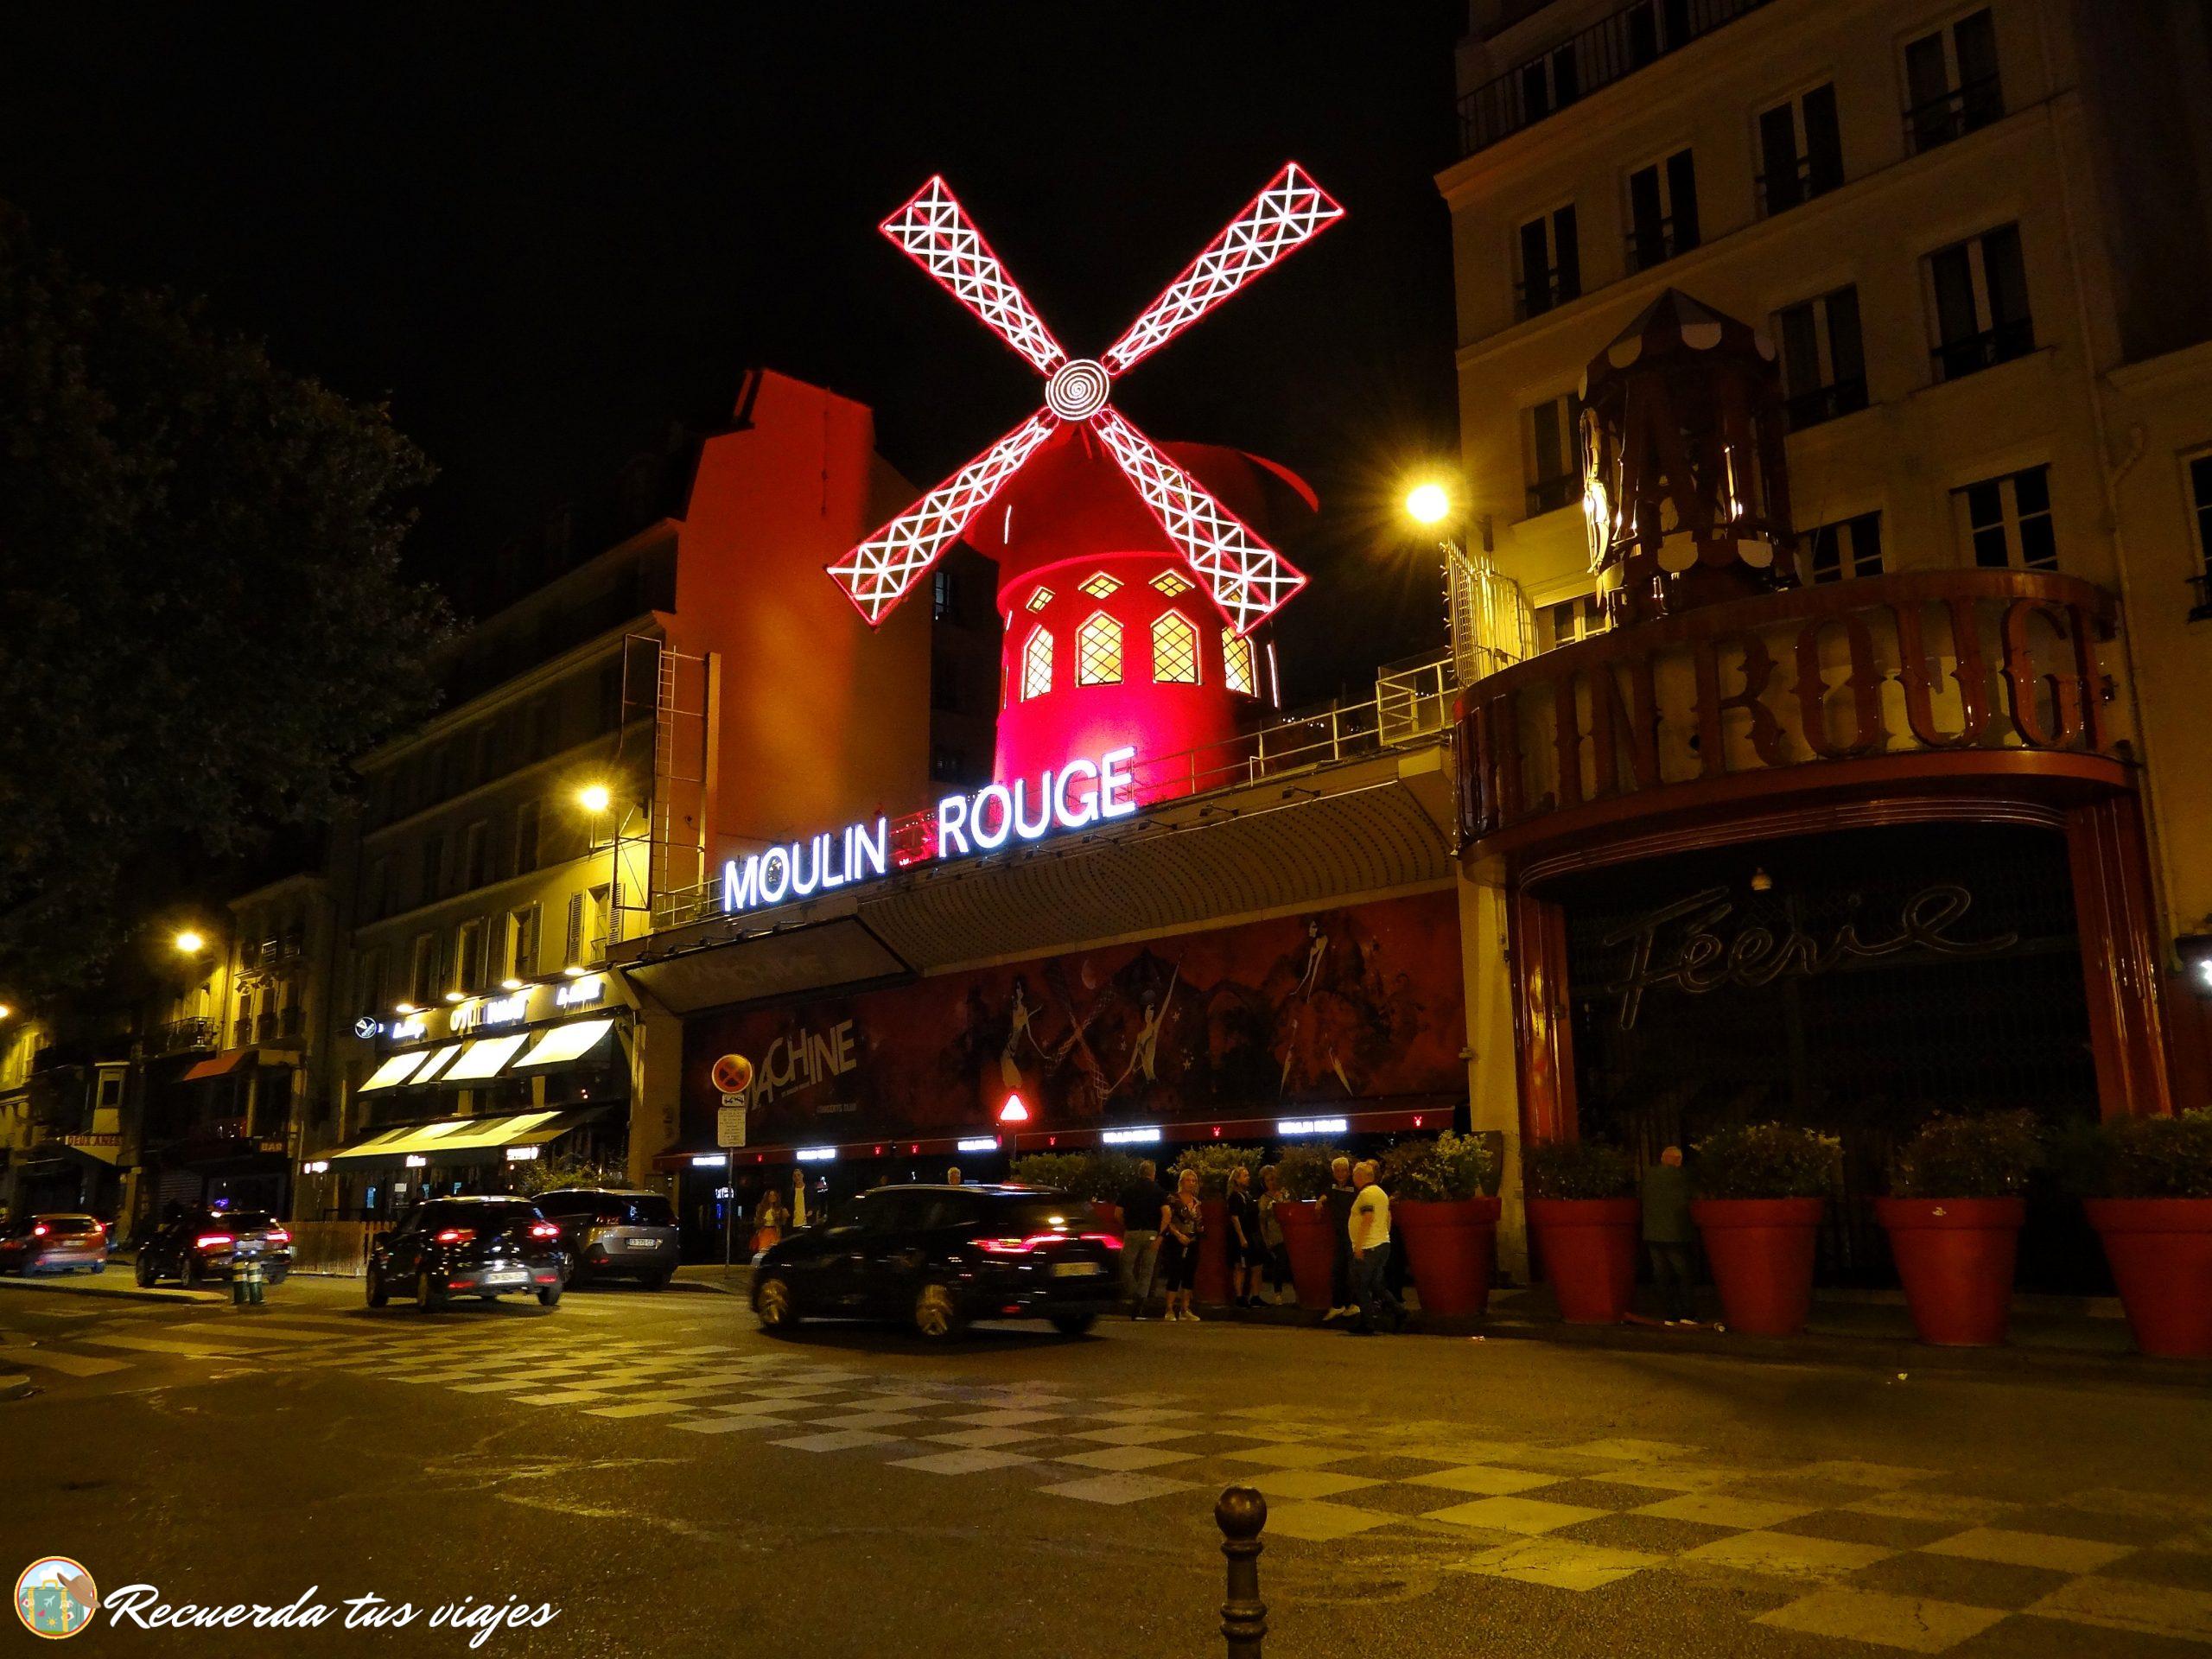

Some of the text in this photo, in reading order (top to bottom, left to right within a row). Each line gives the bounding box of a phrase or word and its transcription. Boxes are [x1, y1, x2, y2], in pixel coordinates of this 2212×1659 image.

[722, 746, 1137, 913] MOULIN ROUGE
[746, 1019, 857, 1112] ACHINE
